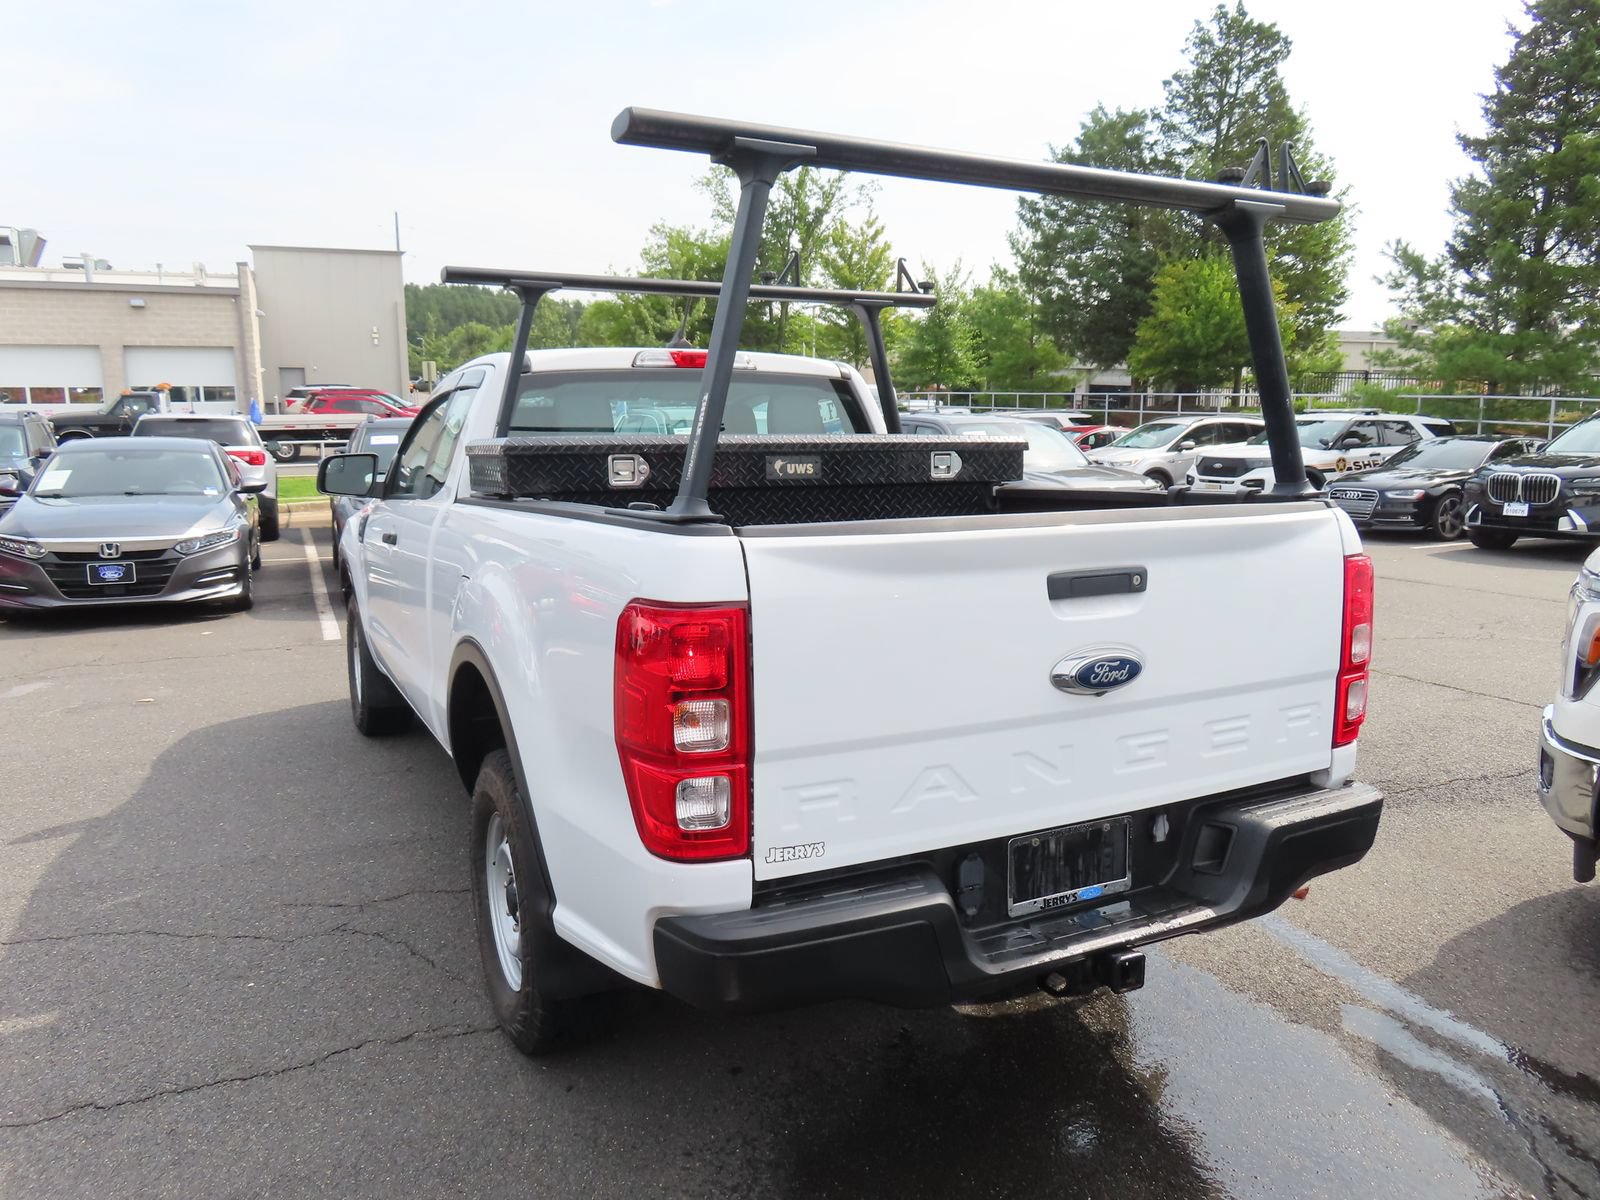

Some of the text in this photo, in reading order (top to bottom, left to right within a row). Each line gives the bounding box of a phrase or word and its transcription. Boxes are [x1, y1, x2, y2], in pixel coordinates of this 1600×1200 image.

[786, 463, 814, 474] UWS
[1090, 660, 1130, 684] Ford
[781, 702, 1320, 832] RANGER
[765, 842, 825, 863] JERRY'S
[1039, 892, 1078, 910] JERRY'S
